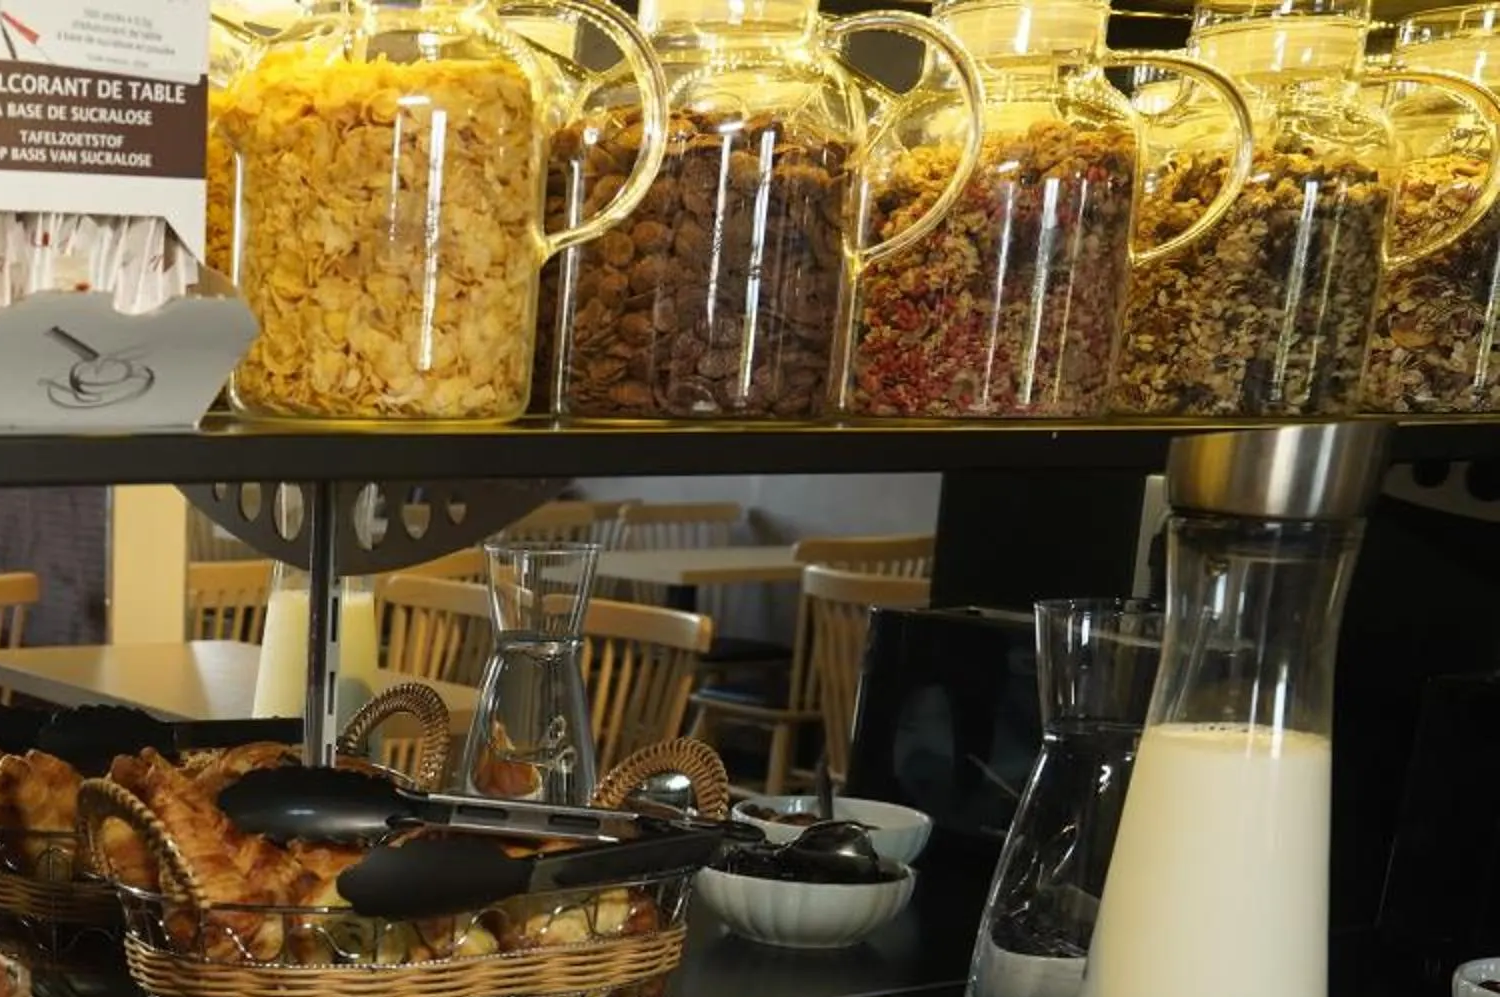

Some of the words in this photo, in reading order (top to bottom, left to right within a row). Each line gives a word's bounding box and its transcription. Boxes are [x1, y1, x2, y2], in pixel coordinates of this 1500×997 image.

[97, 79, 124, 100] DE
[128, 81, 187, 104] TABLE
[7, 103, 43, 120] BASE
[47, 105, 68, 121] DE
[71, 106, 153, 126] SUCRALOSE
[19, 129, 125, 149] TAFELZOETSTOF
[11, 147, 46, 163] BASIS
[49, 149, 77, 164] VAN
[80, 150, 153, 168] SUCRALOSE
